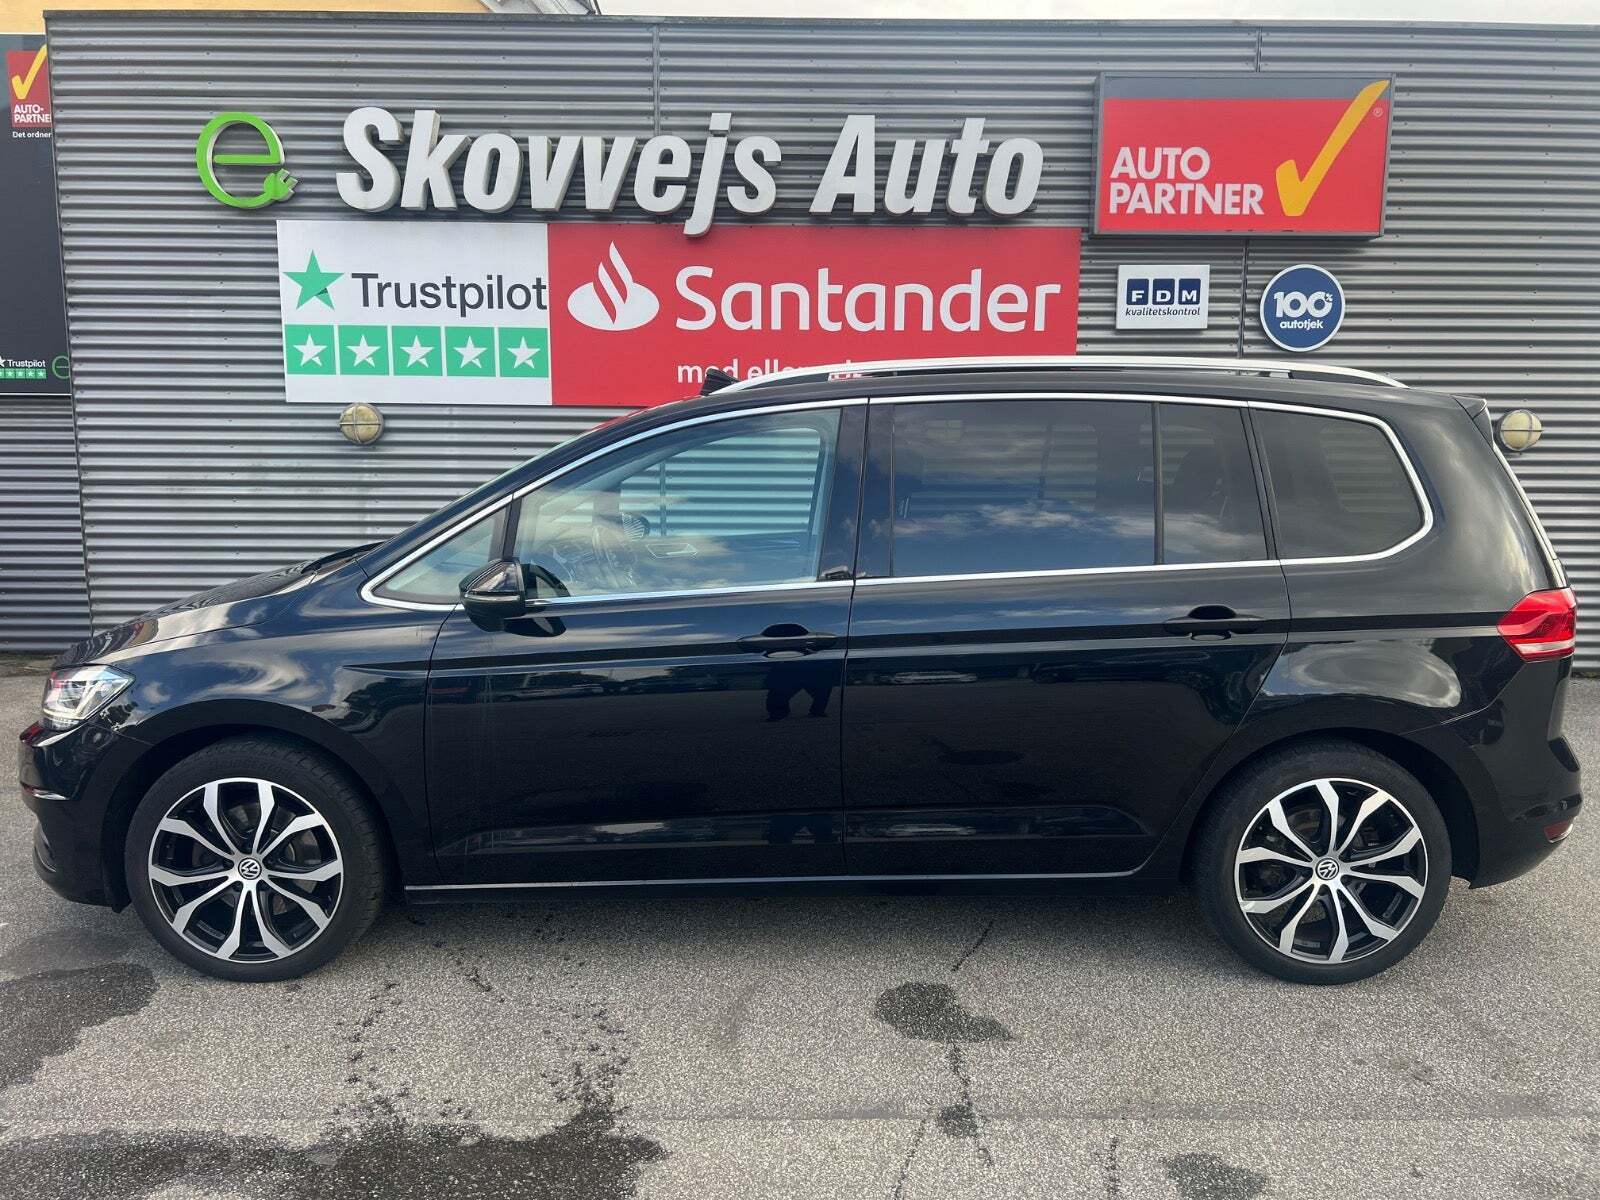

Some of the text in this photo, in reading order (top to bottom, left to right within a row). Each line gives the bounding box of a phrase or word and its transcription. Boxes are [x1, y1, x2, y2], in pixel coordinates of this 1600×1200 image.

[14, 104, 44, 113] AUTO-
[14, 113, 52, 123] PARTNE
[1110, 146, 1211, 180] AUTO
[336, 106, 1045, 236] Skovvejs Auto
[1109, 182, 1265, 215] PARTNER
[351, 272, 548, 318] Trustpilot
[675, 265, 1062, 333] Santander
[1131, 290, 1197, 302] FDM
[1125, 307, 1201, 317] kvalitetskontrol
[1280, 319, 1324, 331] autotjek
[7, 360, 46, 368] Trustpilot
